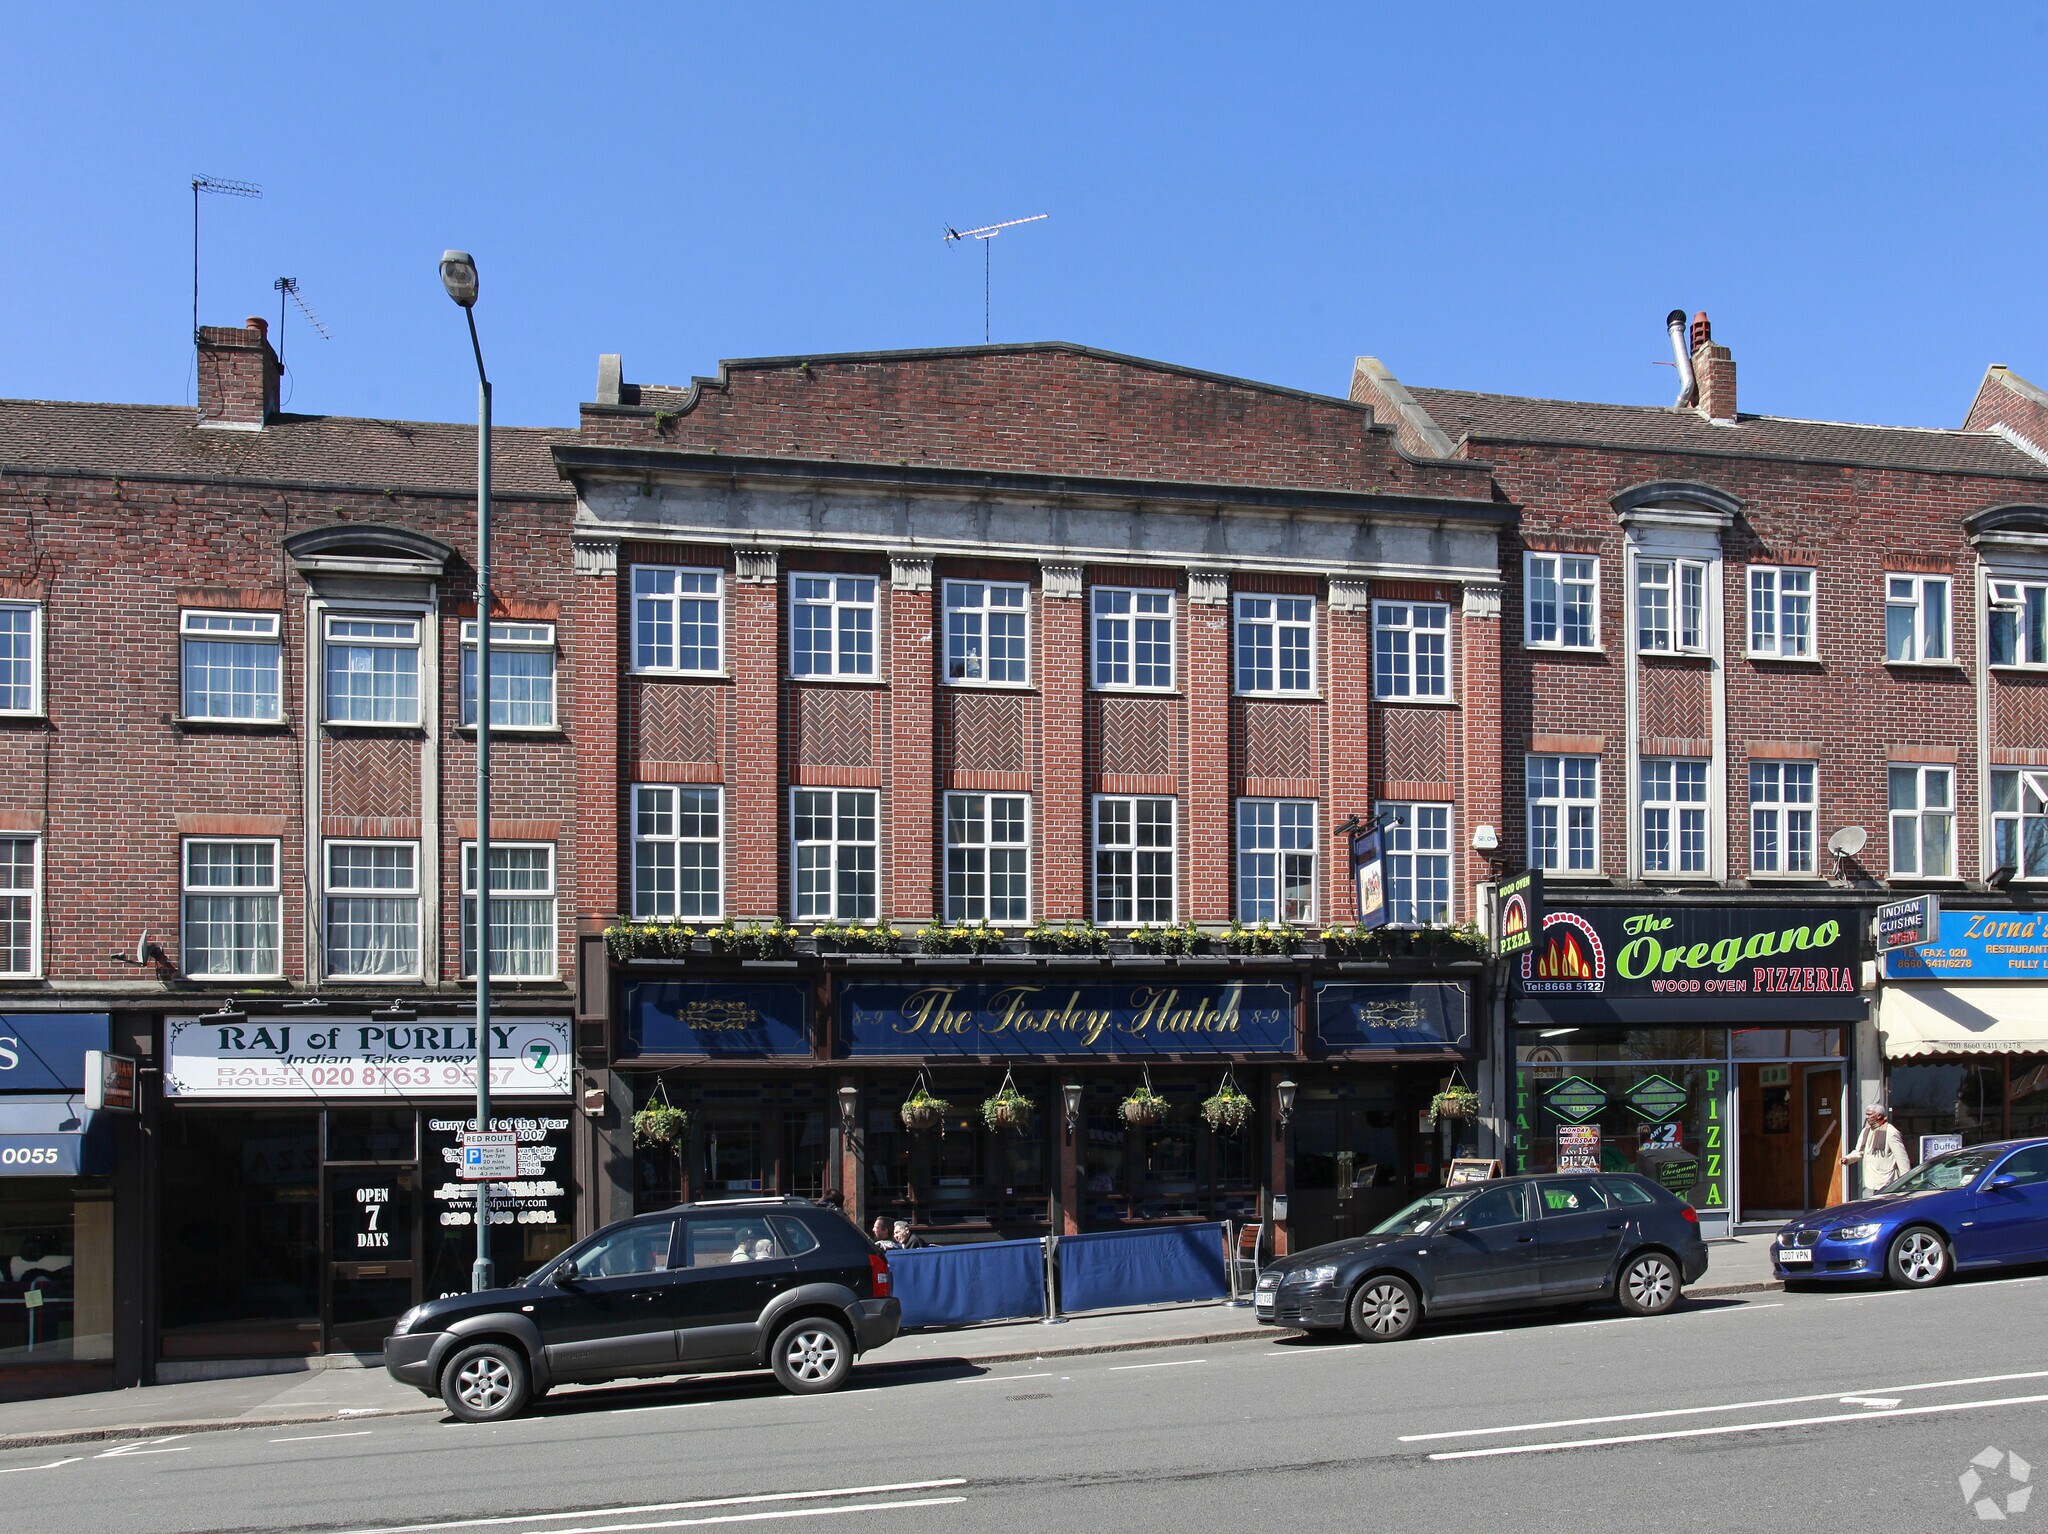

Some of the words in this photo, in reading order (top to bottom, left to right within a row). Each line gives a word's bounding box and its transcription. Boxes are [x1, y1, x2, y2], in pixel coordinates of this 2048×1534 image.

[1499, 882, 1515, 898] WOOD
[1515, 876, 1531, 891] OVEN
[1882, 901, 1920, 918] INDIAN
[1622, 913, 1674, 936] The
[1879, 913, 1922, 933] CUISINE
[1500, 930, 1531, 953] PIZZA
[1616, 919, 1841, 979] Oregano
[1949, 948, 1968, 958] 020
[1985, 944, 2048, 954] RESTAURANT
[1925, 958, 1973, 969] 6411/6278
[2008, 959, 2039, 969] FULLY
[1576, 982, 1601, 991] 5122
[1652, 979, 1701, 993] WOOD
[1704, 979, 1747, 993] OVEN
[1753, 967, 1854, 993] PIZZERIA
[852, 1009, 884, 1026] 8-9
[892, 986, 974, 1035] The
[978, 985, 1111, 1048] Foxley
[1116, 986, 1242, 1039] Hatch
[1250, 1009, 1280, 1025] 8-9
[217, 1026, 292, 1055] RAJ
[306, 1027, 341, 1050] of
[286, 1054, 352, 1065] Indian
[361, 1054, 477, 1065] Take-away
[529, 1045, 551, 1069] 7
[217, 1067, 304, 1077] BALTI
[311, 1067, 355, 1086] 020
[361, 1067, 431, 1086] 8763
[217, 1077, 303, 1086] HOUSE
[429, 1119, 466, 1132] Curry
[466, 1119, 497, 1131] Cf
[498, 1118, 513, 1130] of
[514, 1118, 538, 1130] the
[538, 1118, 569, 1130] Year
[1560, 1126, 1589, 1134] MONDAY
[485, 1134, 513, 1142] ROUTE
[517, 1129, 547, 1142] 2007
[1649, 1126, 1662, 1140] ANY
[1662, 1123, 1677, 1142] 2
[1706, 1069, 1723, 1205] PIZZA
[1559, 1136, 1599, 1145] THURSDAY
[1933, 1142, 1960, 1151] Buffet
[532, 1153, 555, 1162] place
[546, 1145, 557, 1156] by
[1561, 1155, 1597, 1167] PIZZA
[525, 1167, 546, 1176] 2007
[356, 1188, 390, 1203] OPEN
[448, 1198, 548, 1210] www.ofpurley.com
[364, 1204, 381, 1231] 7
[440, 1211, 472, 1226] 020
[474, 1211, 514, 1225] 60
[357, 1232, 390, 1248] DAYS
[1795, 1250, 1809, 1260] VPN
